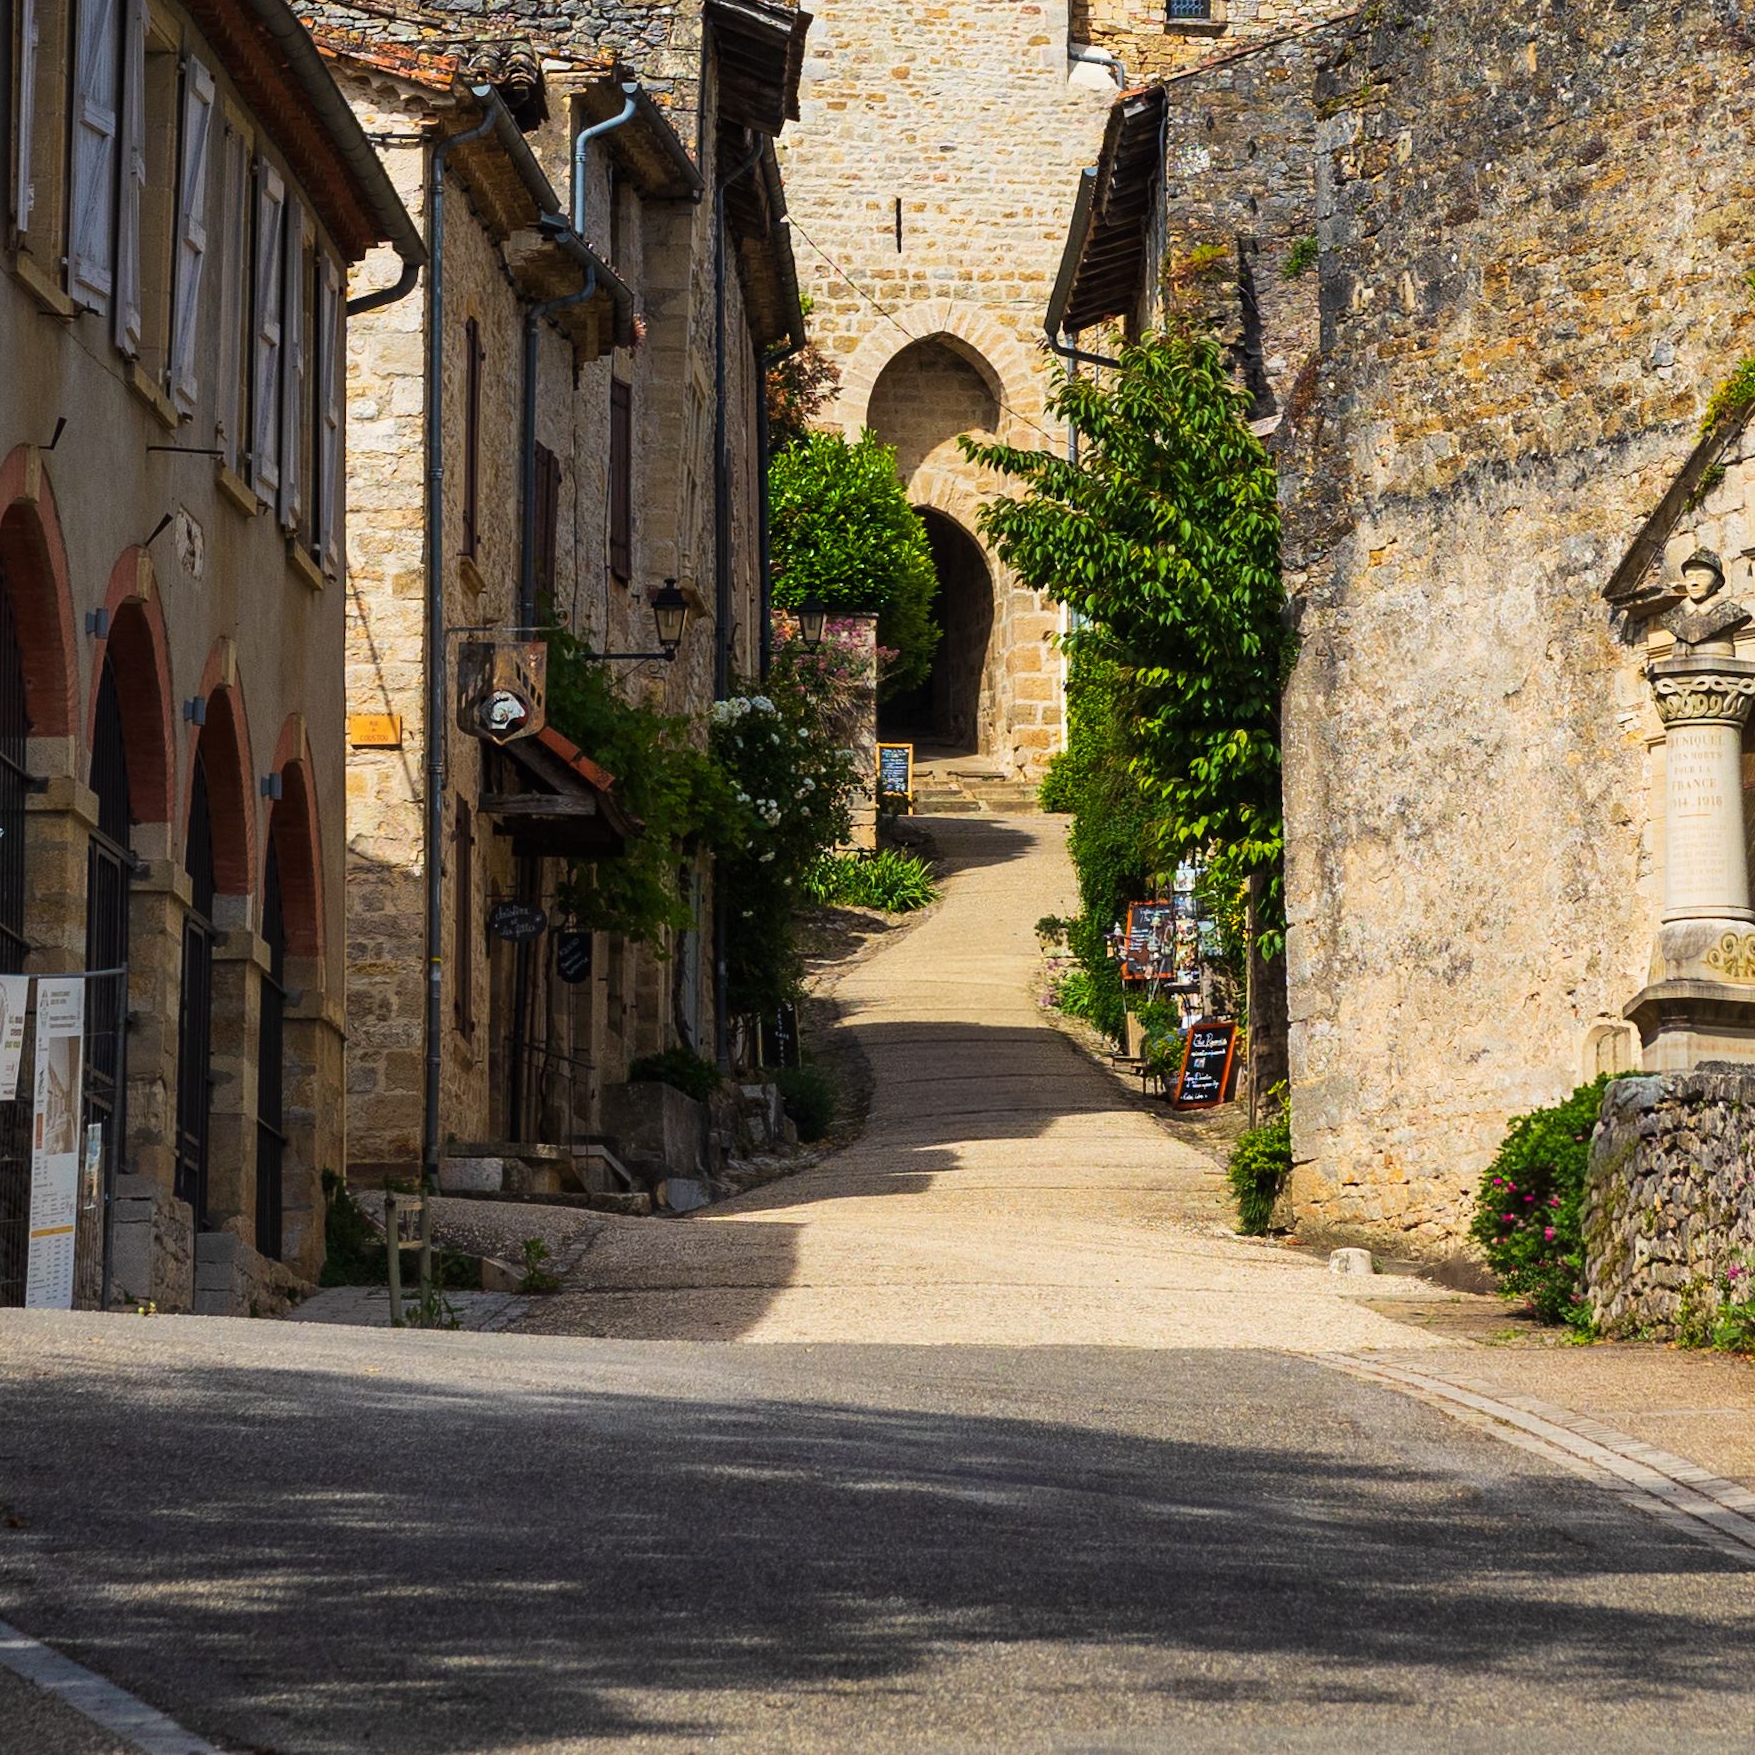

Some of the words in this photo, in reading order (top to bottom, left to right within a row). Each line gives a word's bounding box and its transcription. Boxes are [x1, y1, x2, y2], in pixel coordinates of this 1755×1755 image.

[1667, 734, 1725, 749] RUNIQUEL
[1671, 777, 1717, 792] FRANCE
[1697, 794, 1724, 807] 1918
